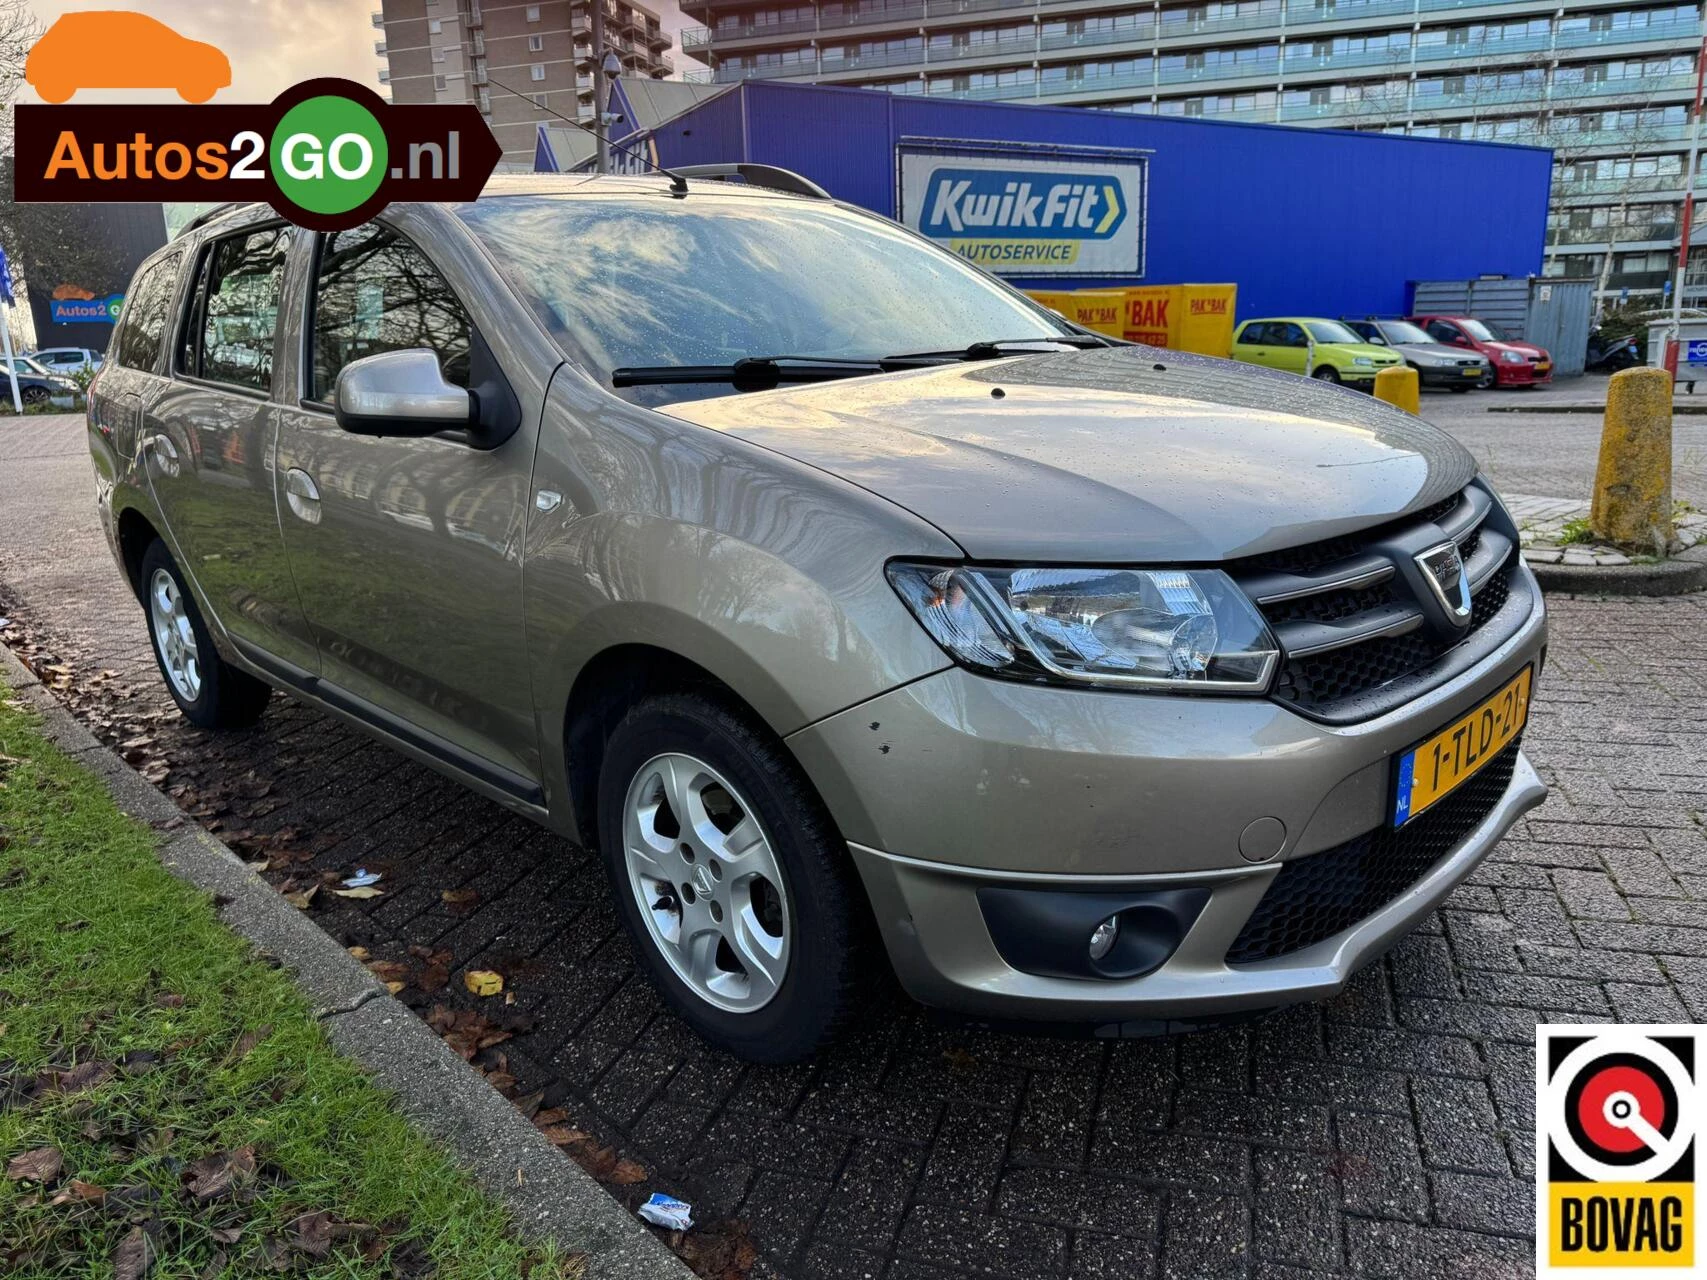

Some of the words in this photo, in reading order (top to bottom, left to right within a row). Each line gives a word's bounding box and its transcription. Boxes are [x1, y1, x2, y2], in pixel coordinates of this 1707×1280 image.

[957, 244, 1072, 260] AUTOSERVICE
[56, 304, 120, 317] Autos2G
[1132, 299, 1169, 328] BAK
[1433, 682, 1520, 791] 1-TLD-21
[1396, 795, 1409, 814] NL
